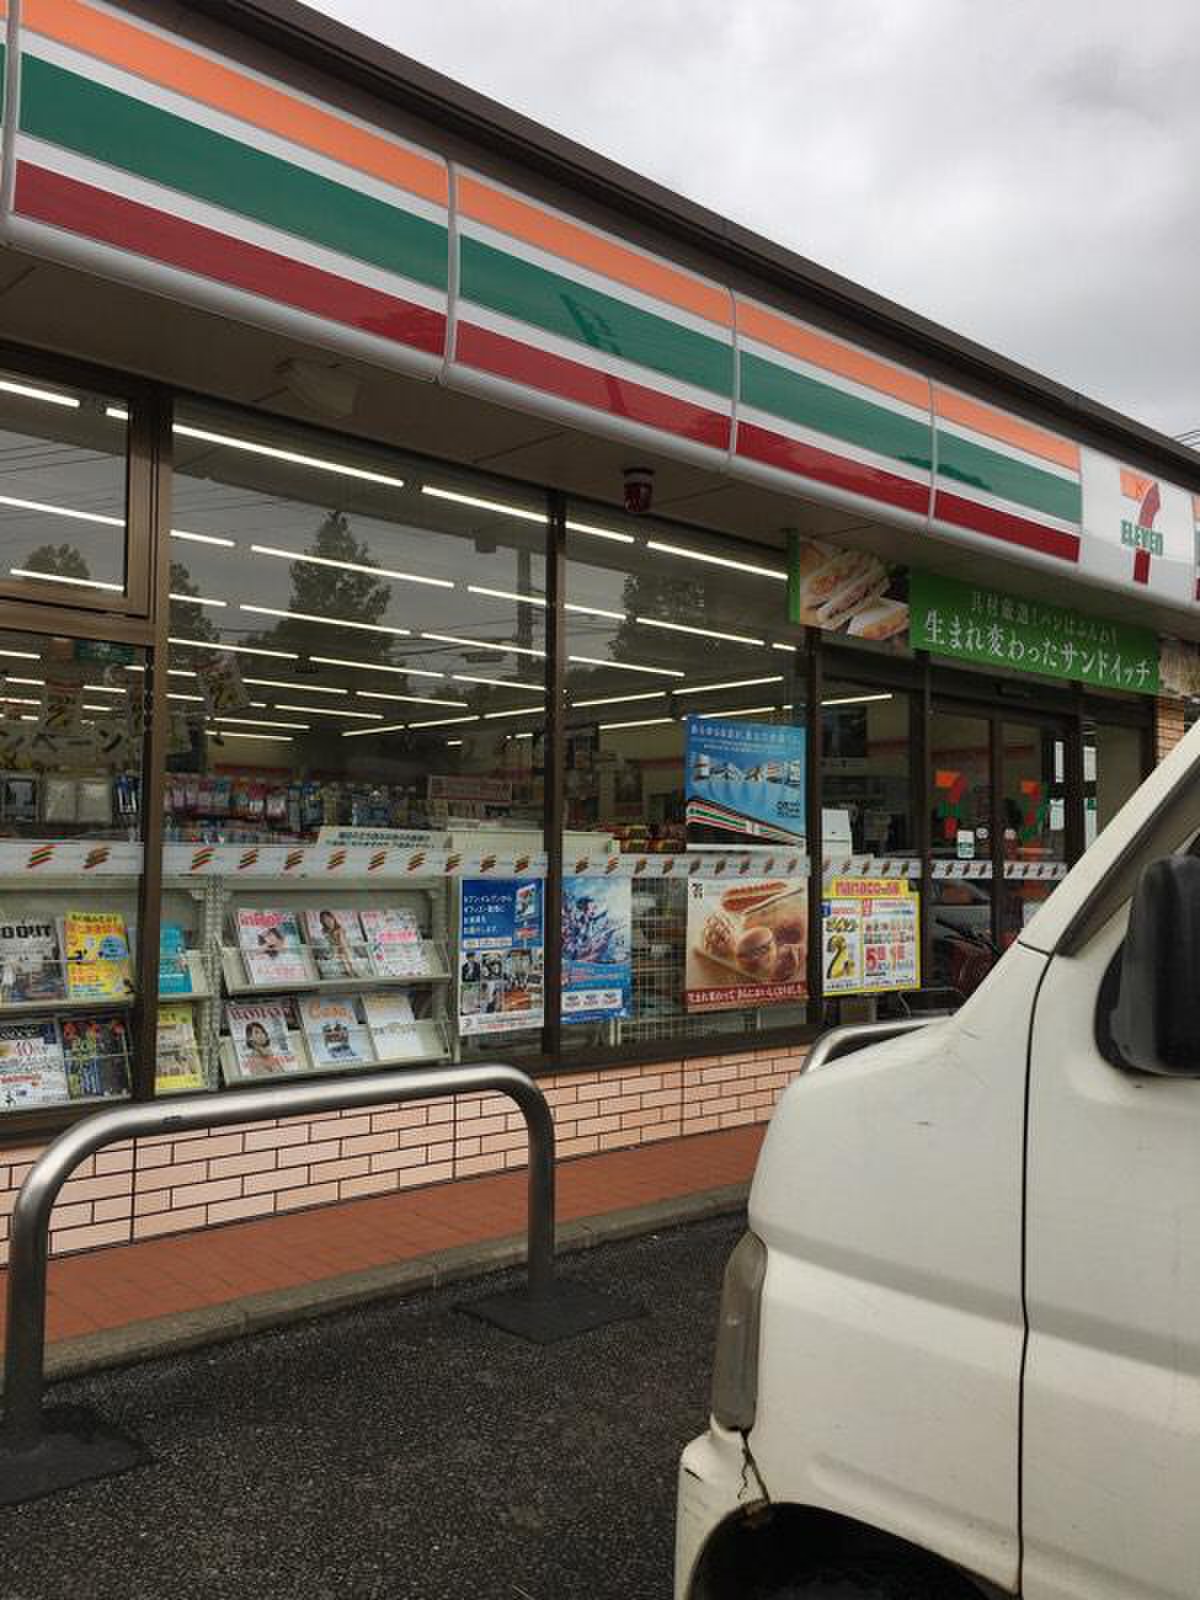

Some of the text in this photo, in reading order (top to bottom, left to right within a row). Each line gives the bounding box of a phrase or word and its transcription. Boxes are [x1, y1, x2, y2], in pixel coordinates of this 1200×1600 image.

[923, 608, 1152, 689] 生まれ変わったサンドイッチ
